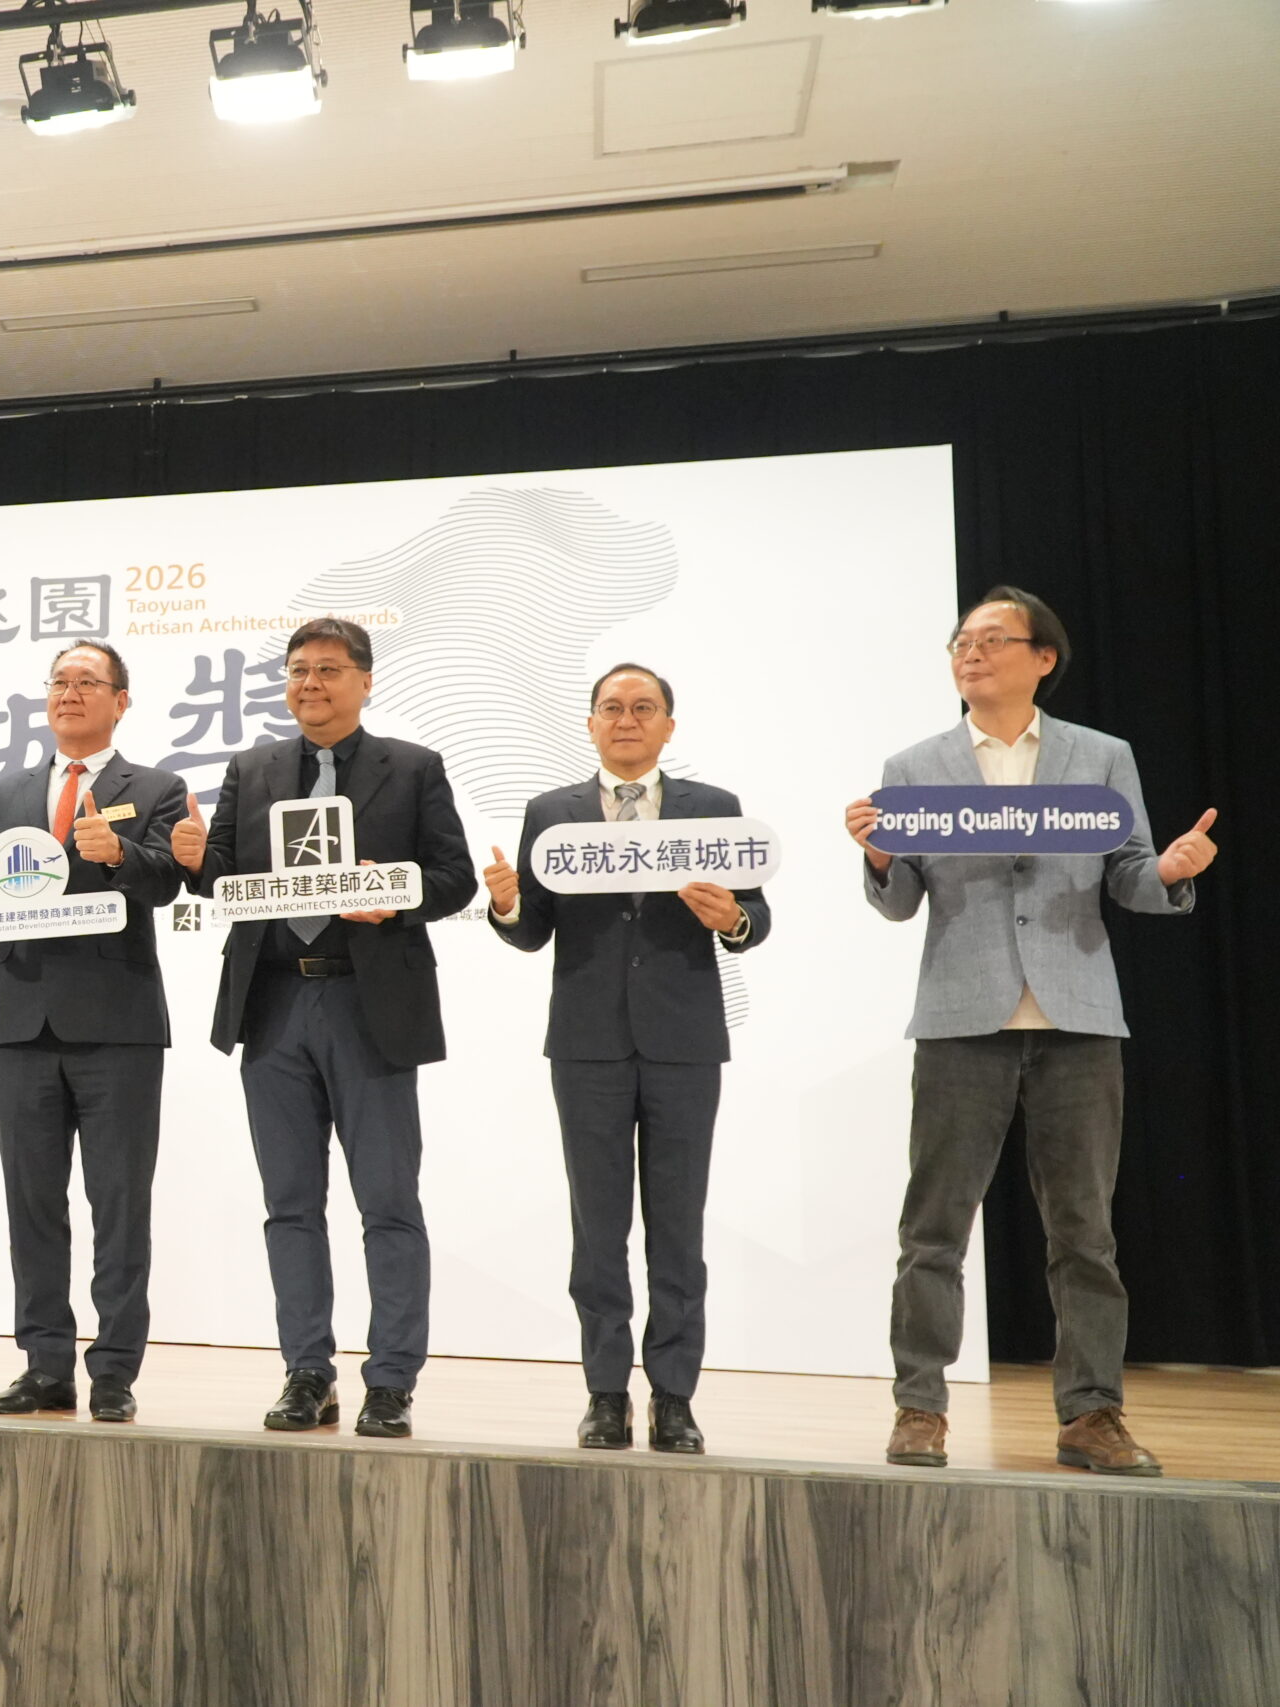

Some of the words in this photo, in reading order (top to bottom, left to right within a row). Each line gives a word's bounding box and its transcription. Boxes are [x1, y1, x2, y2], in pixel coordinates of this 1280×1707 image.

[125, 563, 206, 592] 2026
[127, 597, 206, 616] Taoyuan
[126, 621, 193, 636] Artisan
[874, 807, 953, 836] Forging
[959, 806, 1038, 836] Quality
[1043, 807, 1120, 831] Homes
[543, 837, 770, 876] 成就永續城市
[221, 867, 409, 903] 桃園市建築師公會
[222, 905, 272, 917] TAOYUAN
[275, 900, 337, 912] ARCHITECTS
[340, 895, 411, 908] ASSOCIATION
[18, 918, 70, 930] Development
[71, 916, 118, 926] Association
